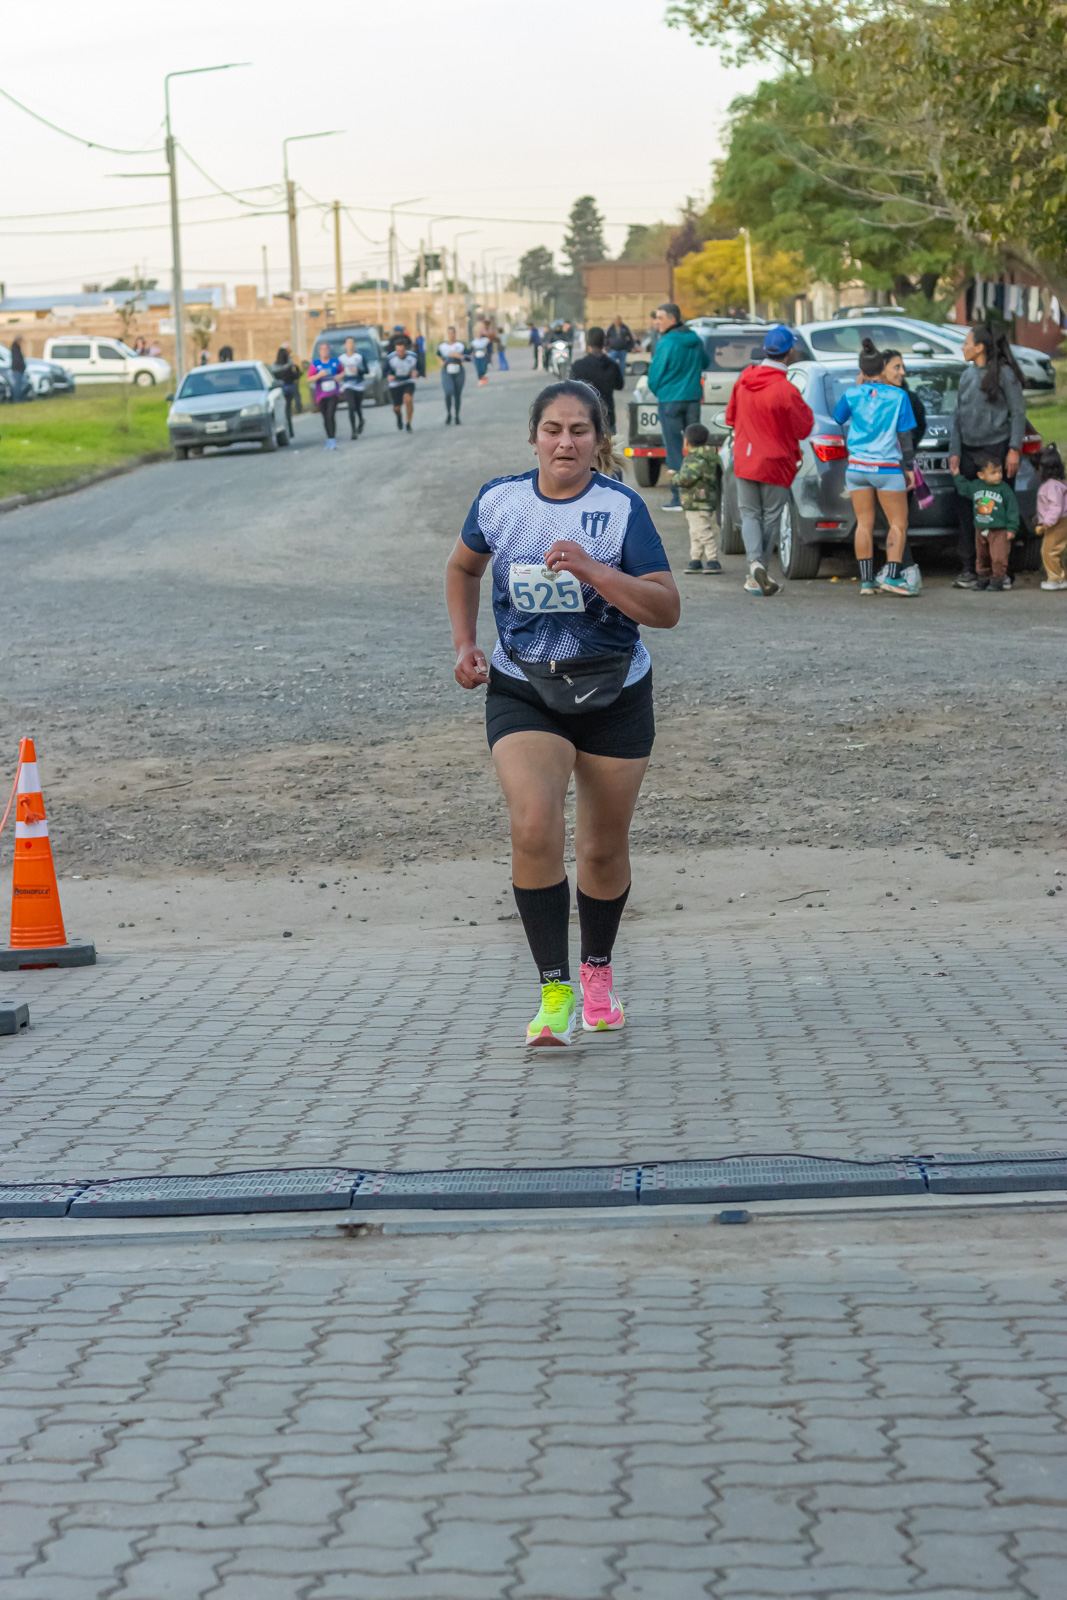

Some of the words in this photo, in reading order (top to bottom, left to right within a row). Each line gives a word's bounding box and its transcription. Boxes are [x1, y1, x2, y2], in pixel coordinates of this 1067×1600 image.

[641, 412, 658, 427] 80
[586, 512, 606, 521] SFC
[513, 581, 580, 610] 525
